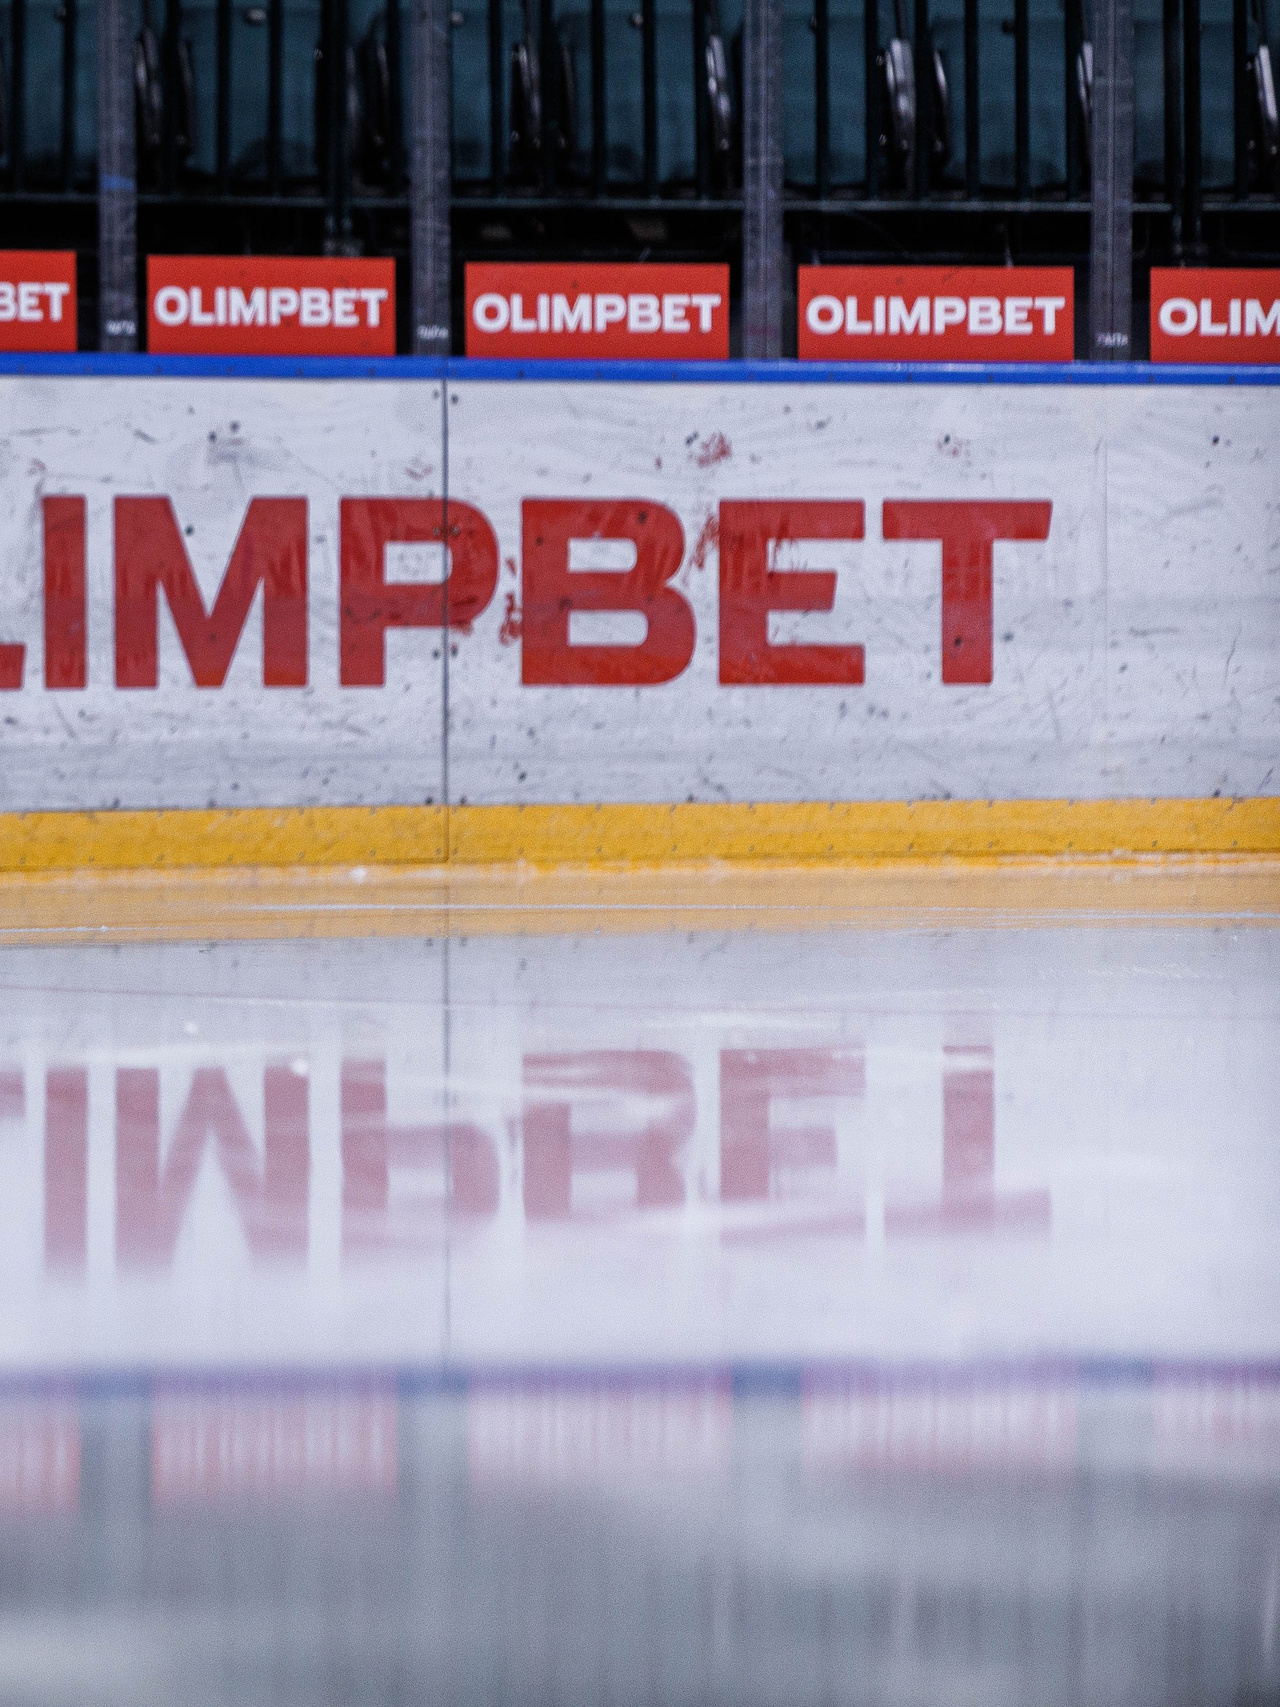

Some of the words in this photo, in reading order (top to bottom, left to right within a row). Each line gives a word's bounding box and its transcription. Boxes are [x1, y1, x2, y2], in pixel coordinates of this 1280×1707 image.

[154, 286, 389, 327] OLIMPBET
[472, 293, 722, 333] OLIMPBET
[806, 295, 1066, 335] OLIMPBET
